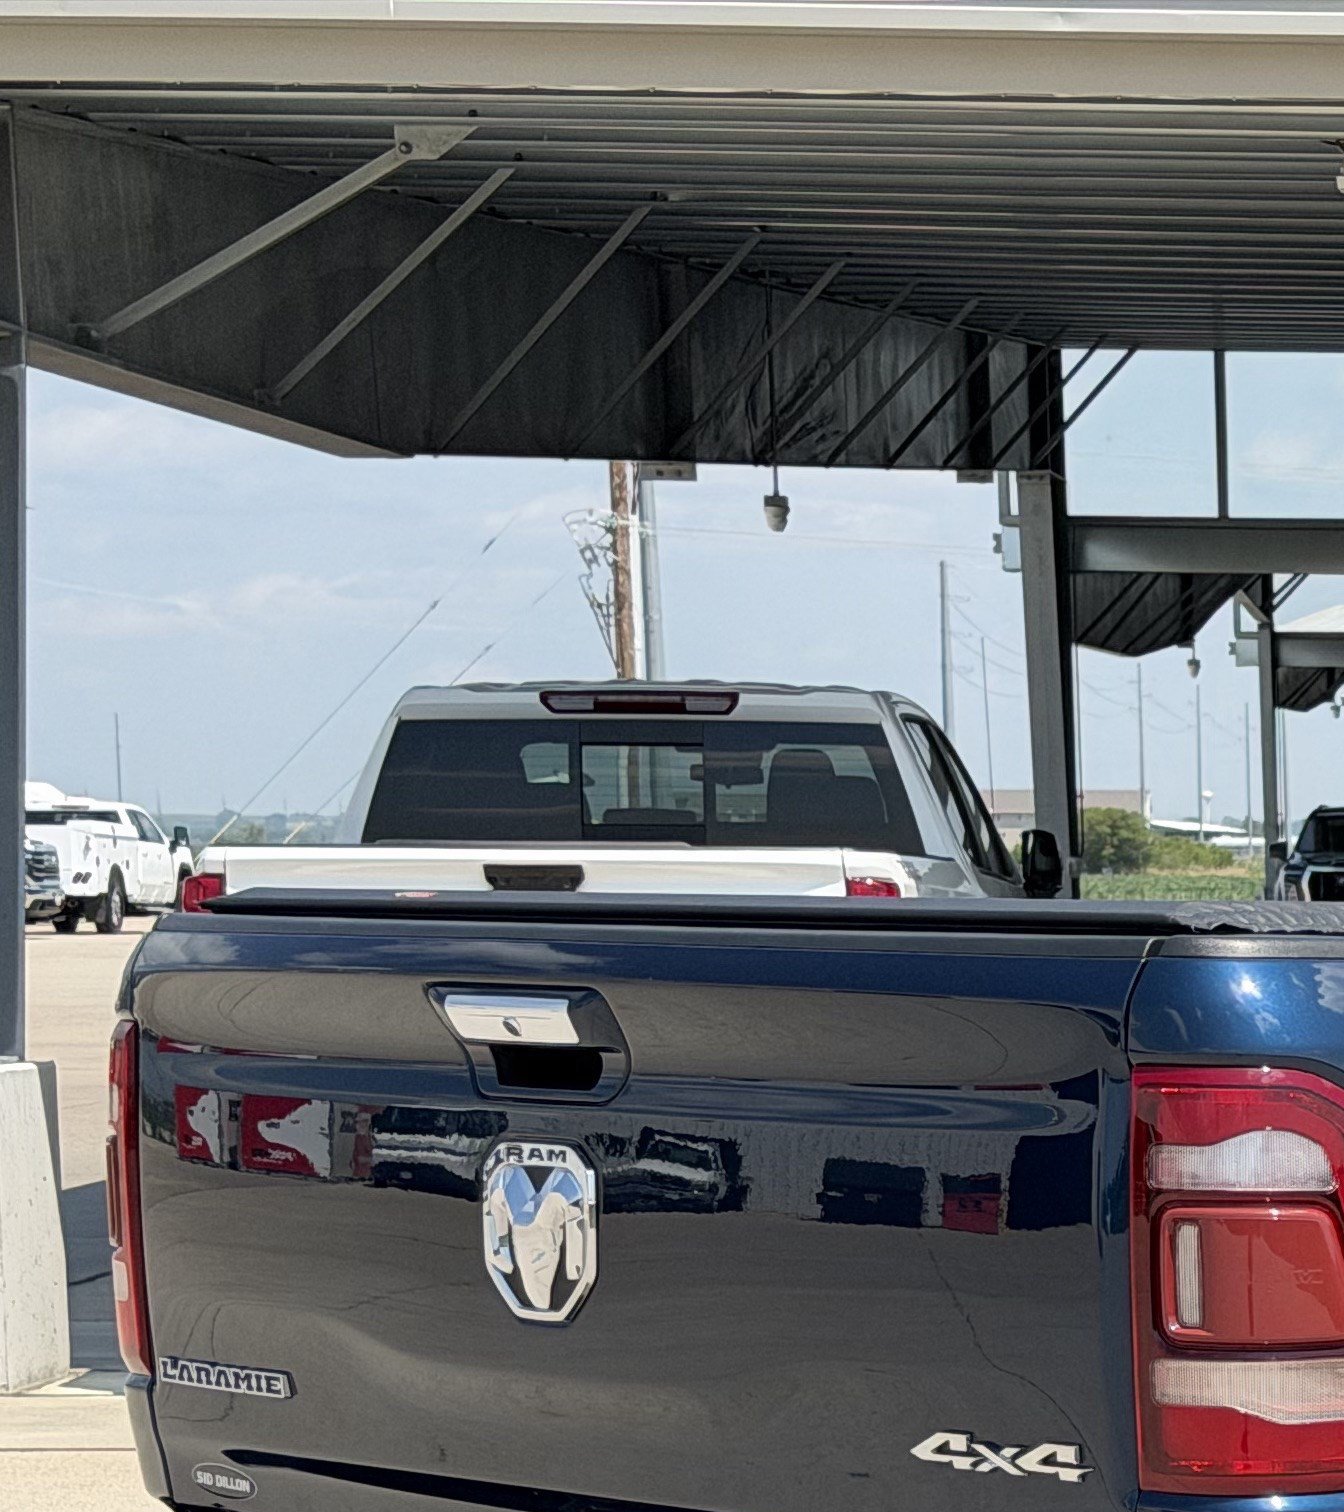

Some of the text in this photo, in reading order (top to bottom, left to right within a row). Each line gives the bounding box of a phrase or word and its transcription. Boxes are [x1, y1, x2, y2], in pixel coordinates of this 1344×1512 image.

[504, 1145, 567, 1163] RAM
[159, 1356, 287, 1399] LARAMIE
[196, 1470, 250, 1493] SID DILLON
